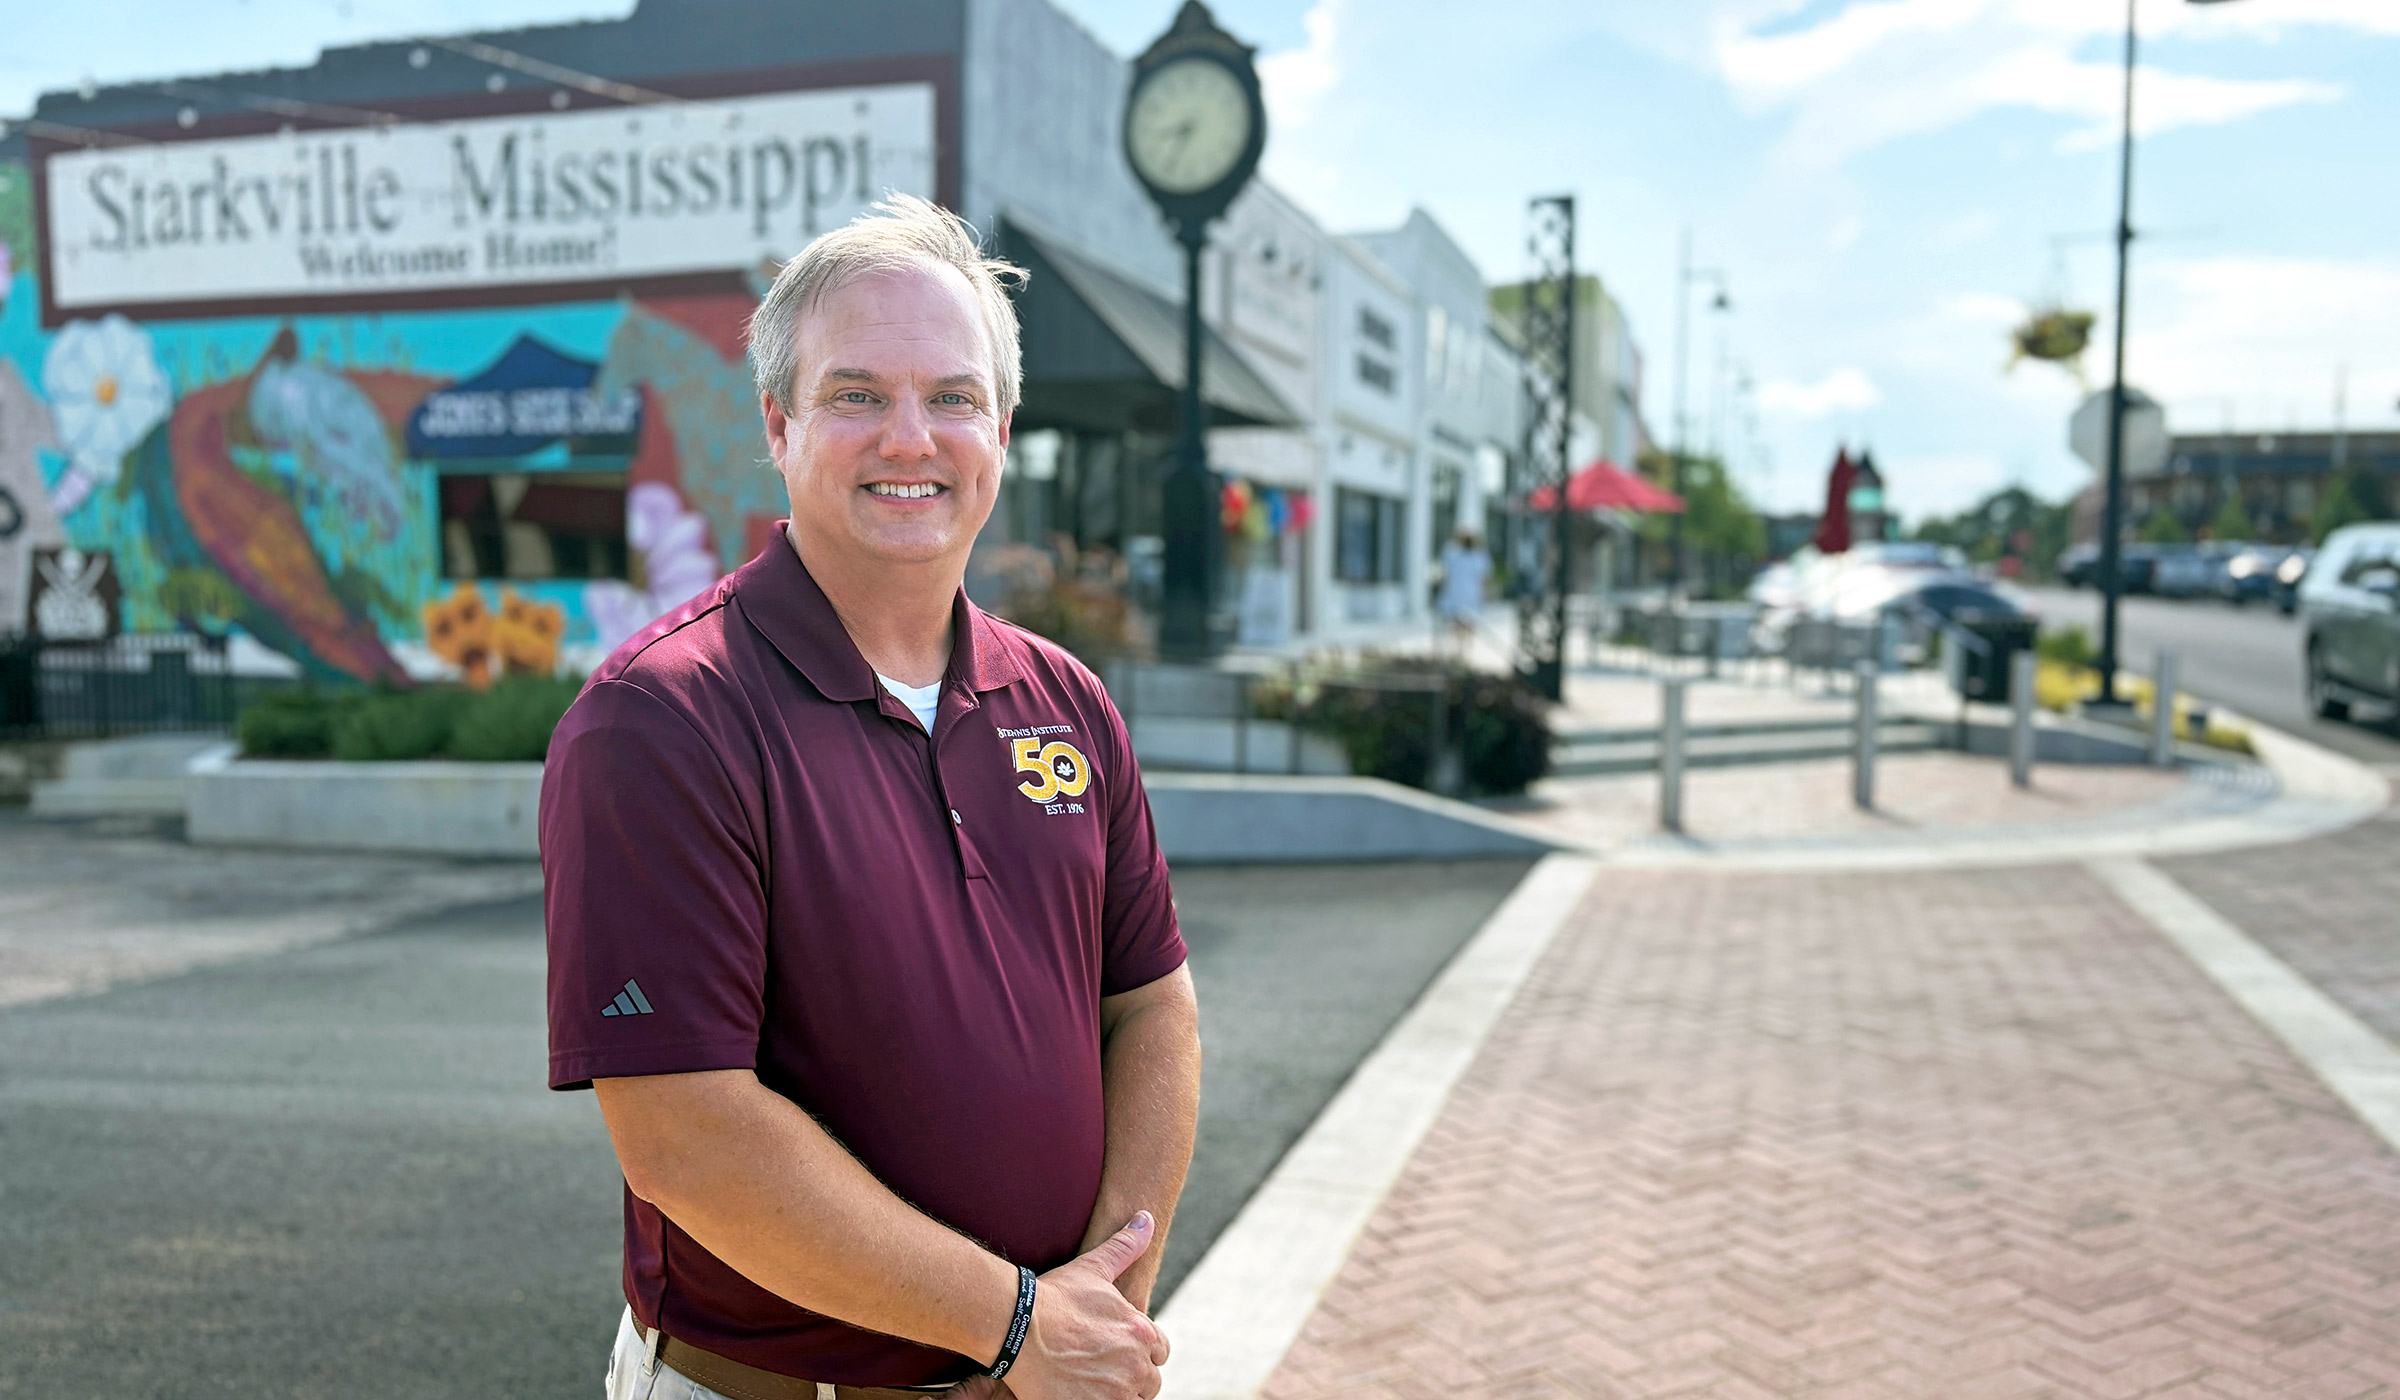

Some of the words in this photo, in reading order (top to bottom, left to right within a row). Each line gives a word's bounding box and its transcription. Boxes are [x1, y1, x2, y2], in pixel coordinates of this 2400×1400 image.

[88, 143, 403, 250] Starkville
[452, 100, 873, 237] Mississippi
[300, 244, 470, 277] Welcome
[485, 228, 618, 270] Home!
[996, 726, 1031, 739] STENNIS
[1031, 724, 1073, 737] INSTITUTE
[1011, 737, 1091, 803] 50
[1044, 803, 1066, 815] EST.
[1067, 803, 1084, 814] 1976
[1004, 1297, 1026, 1349] Self-Control
[1011, 1313, 1031, 1355] Goodness
